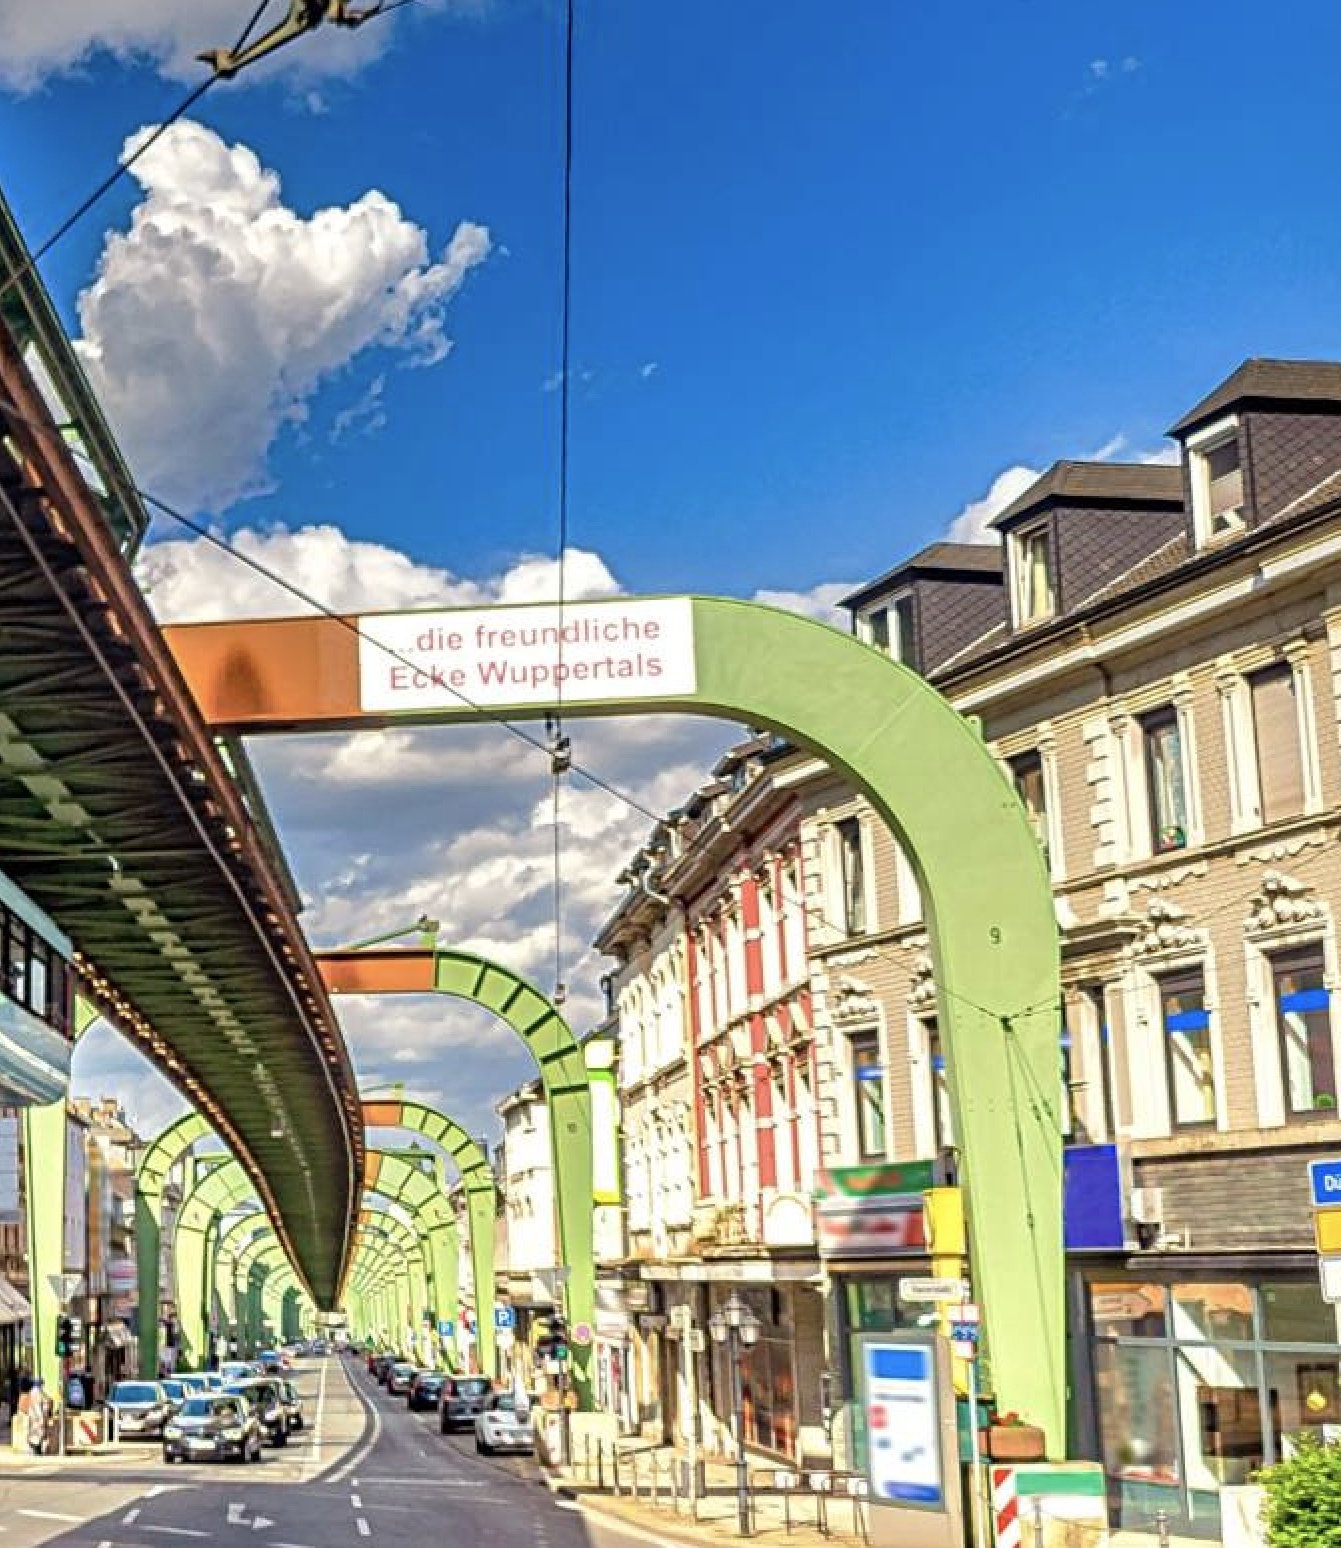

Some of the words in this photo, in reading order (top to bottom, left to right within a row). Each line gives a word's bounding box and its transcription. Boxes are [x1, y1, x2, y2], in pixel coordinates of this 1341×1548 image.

[475, 616, 661, 649] freundliche
[390, 663, 467, 690] Ecke
[477, 653, 664, 689] Wuppertals
[989, 926, 1002, 945] 9
